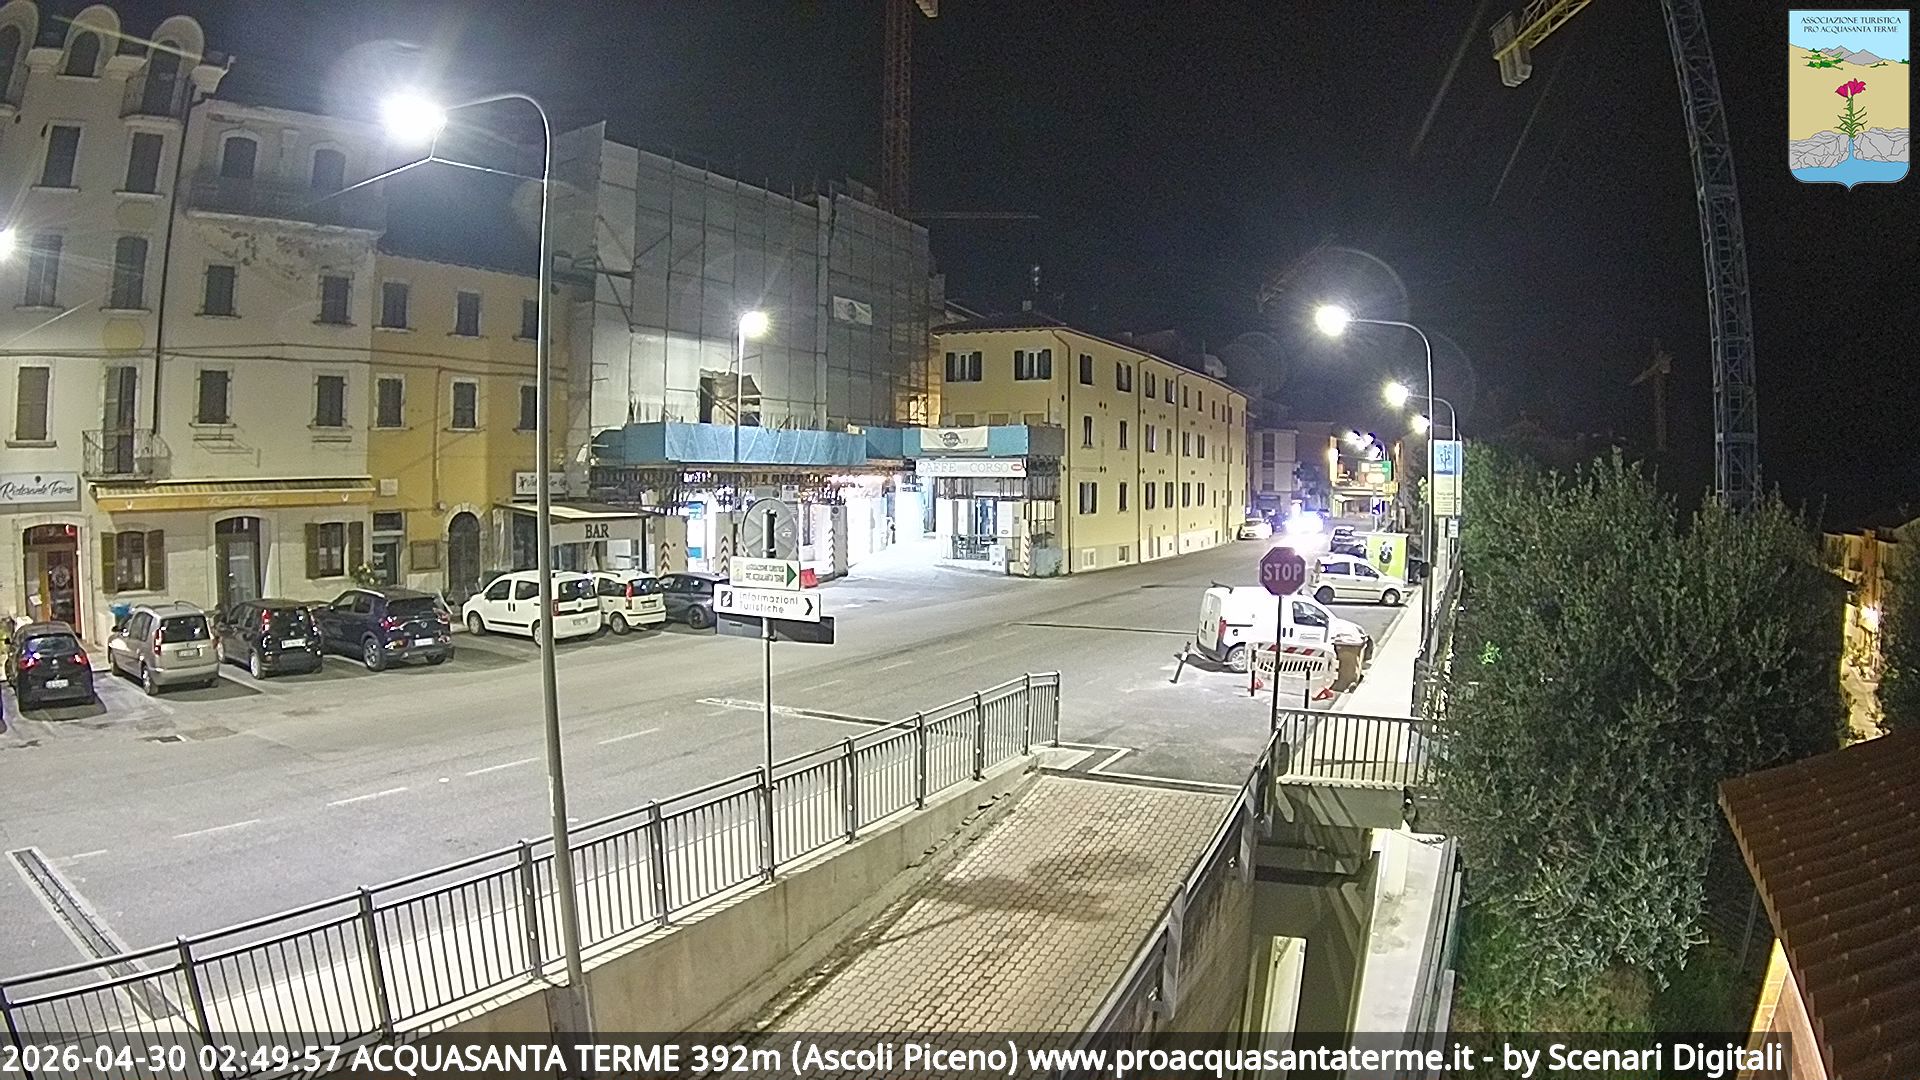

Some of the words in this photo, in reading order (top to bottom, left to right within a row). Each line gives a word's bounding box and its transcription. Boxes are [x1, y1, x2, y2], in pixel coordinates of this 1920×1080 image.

[969, 463, 1009, 473] CORSO
[585, 524, 609, 539] BAR
[1264, 563, 1302, 581] STOP
